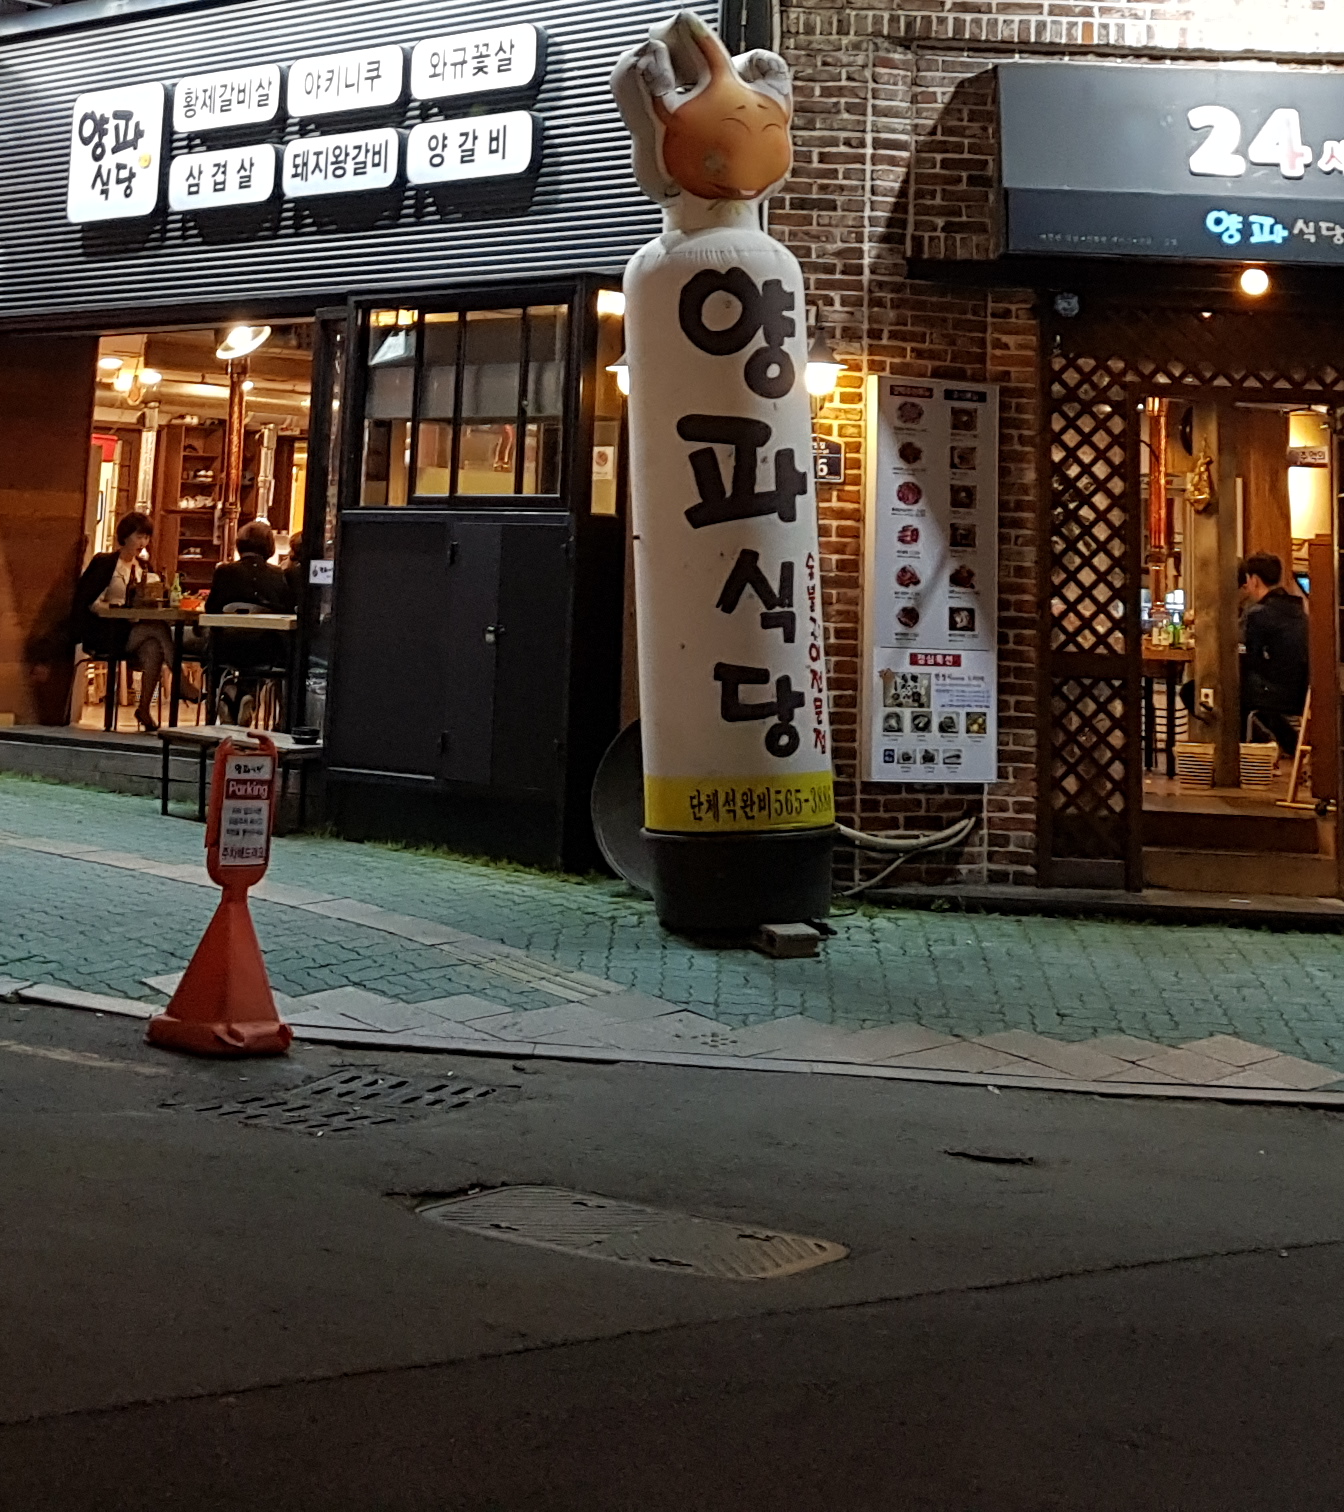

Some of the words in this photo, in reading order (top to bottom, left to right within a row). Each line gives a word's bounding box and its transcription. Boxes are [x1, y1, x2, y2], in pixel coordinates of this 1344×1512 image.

[304, 59, 383, 100] 야키니쿠
[427, 38, 517, 82] 와규꽃살
[181, 76, 273, 119] 황제갈비살
[77, 108, 146, 163] 양파
[427, 128, 509, 168] 양갈비
[90, 162, 138, 201] 식당
[184, 156, 256, 196] 삼겹살
[290, 138, 390, 184] 돼지왕갈비
[228, 780, 269, 800] Parking
